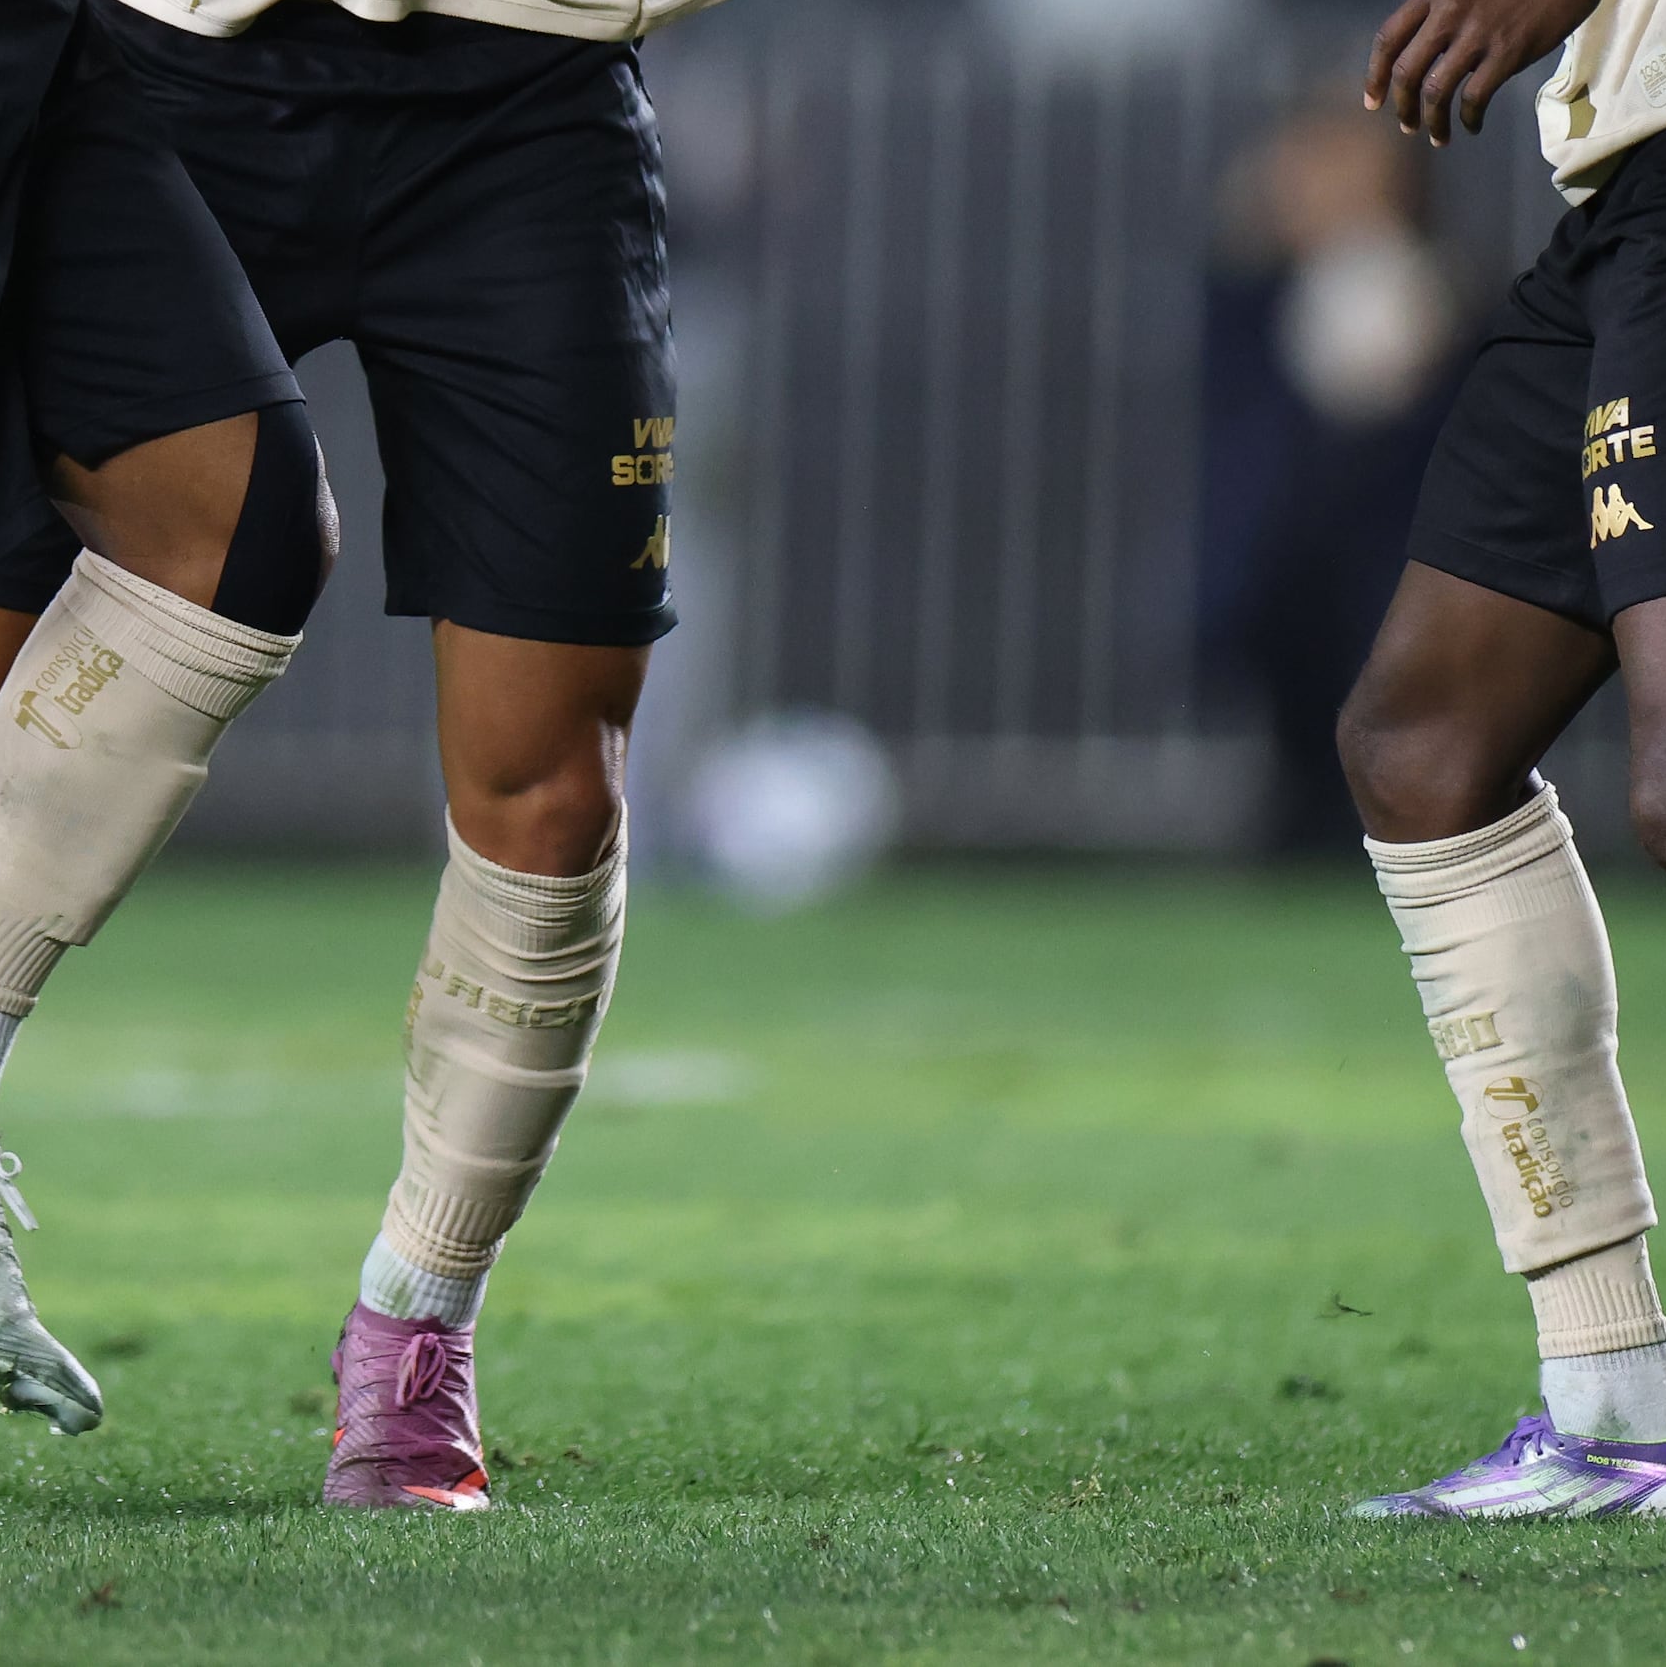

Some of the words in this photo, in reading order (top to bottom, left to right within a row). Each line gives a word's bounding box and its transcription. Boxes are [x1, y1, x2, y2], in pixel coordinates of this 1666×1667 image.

[1582, 425, 1657, 479] ORTE
[53, 644, 124, 715] tradiçã
[1501, 1121, 1553, 1218] tradição
[1586, 1454, 1610, 1466] DIOS
